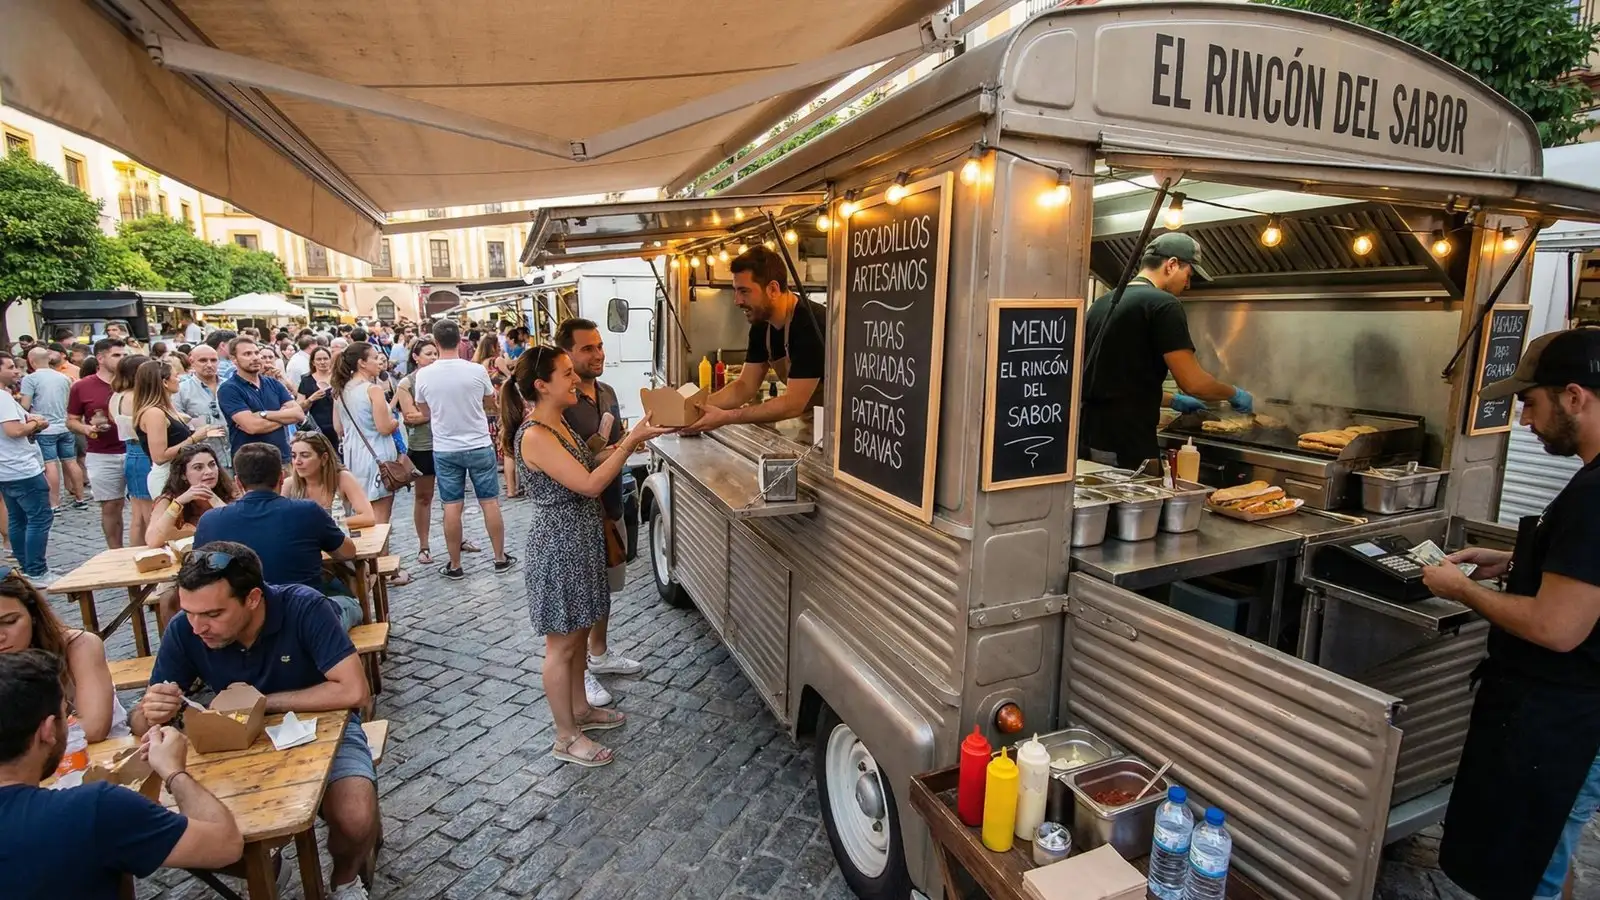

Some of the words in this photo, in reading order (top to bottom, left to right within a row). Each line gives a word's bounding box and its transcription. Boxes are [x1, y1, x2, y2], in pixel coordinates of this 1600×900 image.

[1152, 33, 1191, 110] EL
[1204, 43, 1326, 130] RINCÓN
[1333, 71, 1380, 141] DEL
[1389, 83, 1468, 155] SABOR
[852, 258, 928, 293] ARTESANOS
[863, 320, 905, 350] TAPAS
[1010, 316, 1066, 346] MENÚ
[854, 352, 916, 388] VARIADAS
[1000, 361, 1017, 378] EL
[1021, 354, 1069, 377] RINCÓN
[1024, 382, 1047, 398] DEL
[851, 396, 906, 437] PATATAS
[1007, 403, 1062, 428] SABOR
[854, 427, 902, 469] BRAVAS
